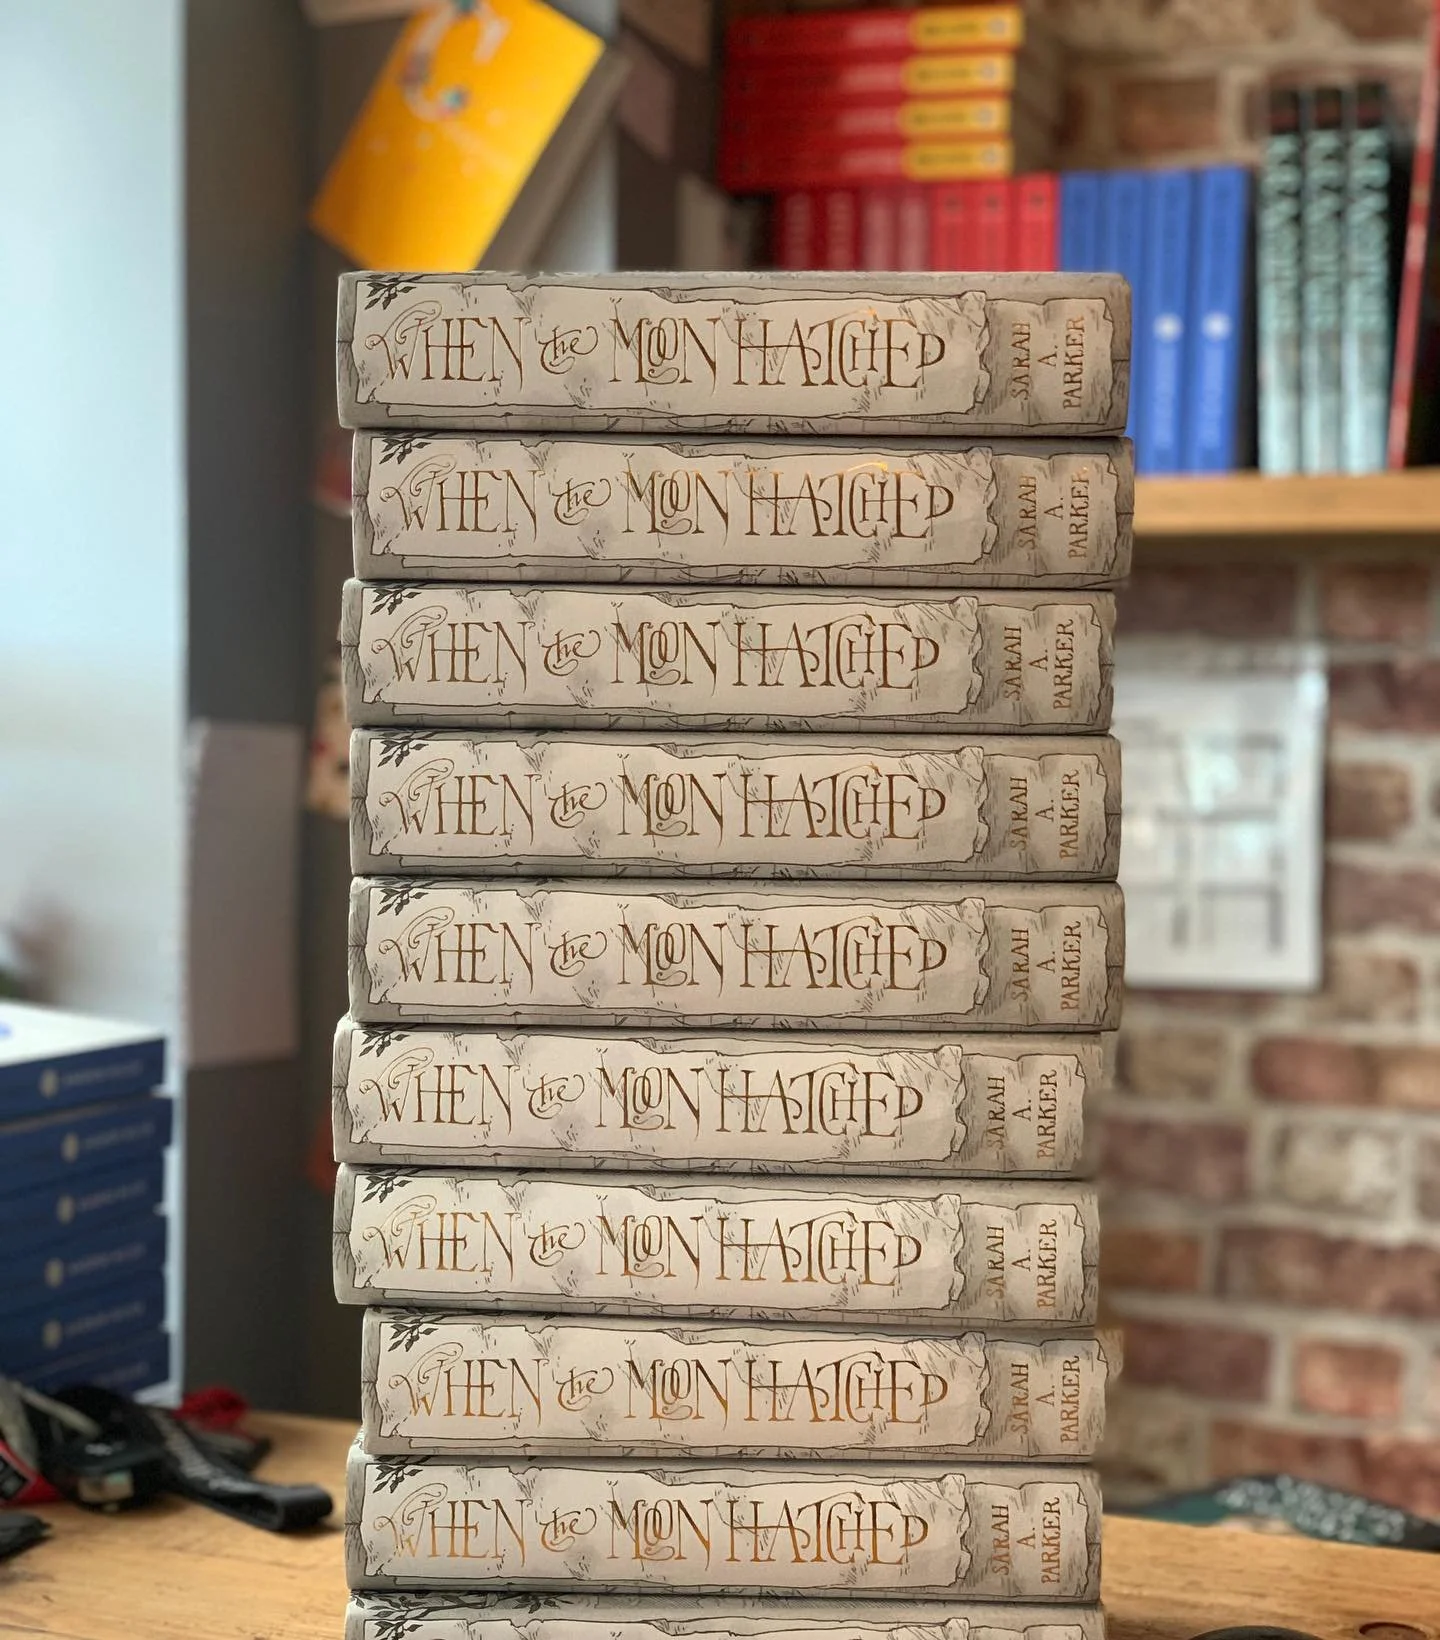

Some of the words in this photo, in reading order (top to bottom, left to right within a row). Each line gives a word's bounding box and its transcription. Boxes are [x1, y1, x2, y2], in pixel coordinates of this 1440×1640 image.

[365, 300, 532, 391] WHEN
[538, 325, 598, 374] the
[608, 317, 721, 397] MOON
[733, 307, 945, 388] HATCHED
[1011, 323, 1030, 400] SARAH
[1038, 345, 1058, 367] A.
[1063, 316, 1084, 409] PARKER
[383, 454, 541, 539] WHEN
[552, 478, 611, 526] the
[621, 470, 731, 548] MOON
[745, 461, 953, 539] HATCHED
[1018, 475, 1036, 550] SARAH
[1044, 497, 1065, 519] A.
[374, 605, 531, 689] WHEN
[542, 629, 600, 676] the
[610, 622, 719, 698] MOON
[732, 612, 939, 689] HATCHED
[1003, 627, 1021, 701] SARAH
[1029, 649, 1049, 669] A.
[1053, 618, 1073, 709] PARKER
[382, 758, 537, 842] WHEN
[548, 781, 607, 828] the
[617, 773, 725, 849] MOON
[739, 763, 945, 840] HATCHED
[1009, 777, 1027, 851] SARAH
[1035, 798, 1055, 819] A.
[1059, 768, 1079, 859] PARKER
[380, 906, 537, 990] WHEN
[548, 930, 607, 977] the
[617, 923, 726, 999] MOON
[739, 913, 946, 991] HATCHED
[1010, 928, 1028, 1002] SARAH
[1036, 951, 1057, 971] A.
[1060, 920, 1081, 1010] PARKER
[361, 1048, 516, 1130] WHEN
[527, 1073, 585, 1119] the
[595, 1067, 703, 1142] MOON
[716, 1060, 922, 1136] HATCHED
[985, 1077, 1003, 1149] SARAH
[1011, 1099, 1031, 1119] A.
[1035, 1069, 1056, 1158] PARKER
[361, 1195, 516, 1277] WHEN
[527, 1221, 585, 1266] the
[595, 1215, 703, 1289] MOON
[716, 1209, 922, 1284] HATCHED
[985, 1227, 1004, 1299] SARAH
[1012, 1249, 1032, 1269] A.
[1035, 1219, 1057, 1308] PARKER
[390, 1342, 544, 1423] WHEN
[556, 1366, 614, 1411] the
[624, 1358, 731, 1431] MOON
[744, 1349, 948, 1423] HATCHED
[1010, 1363, 1028, 1434] SARAH
[1036, 1385, 1056, 1405] A.
[1059, 1355, 1080, 1442] PARKER
[375, 1483, 529, 1564] WHEN
[540, 1507, 597, 1552] the
[607, 1500, 713, 1573] MOON
[726, 1491, 927, 1565] HATCHED
[991, 1505, 1008, 1576] SARAH
[1017, 1527, 1035, 1547] A.
[1039, 1497, 1059, 1584] PARKER
